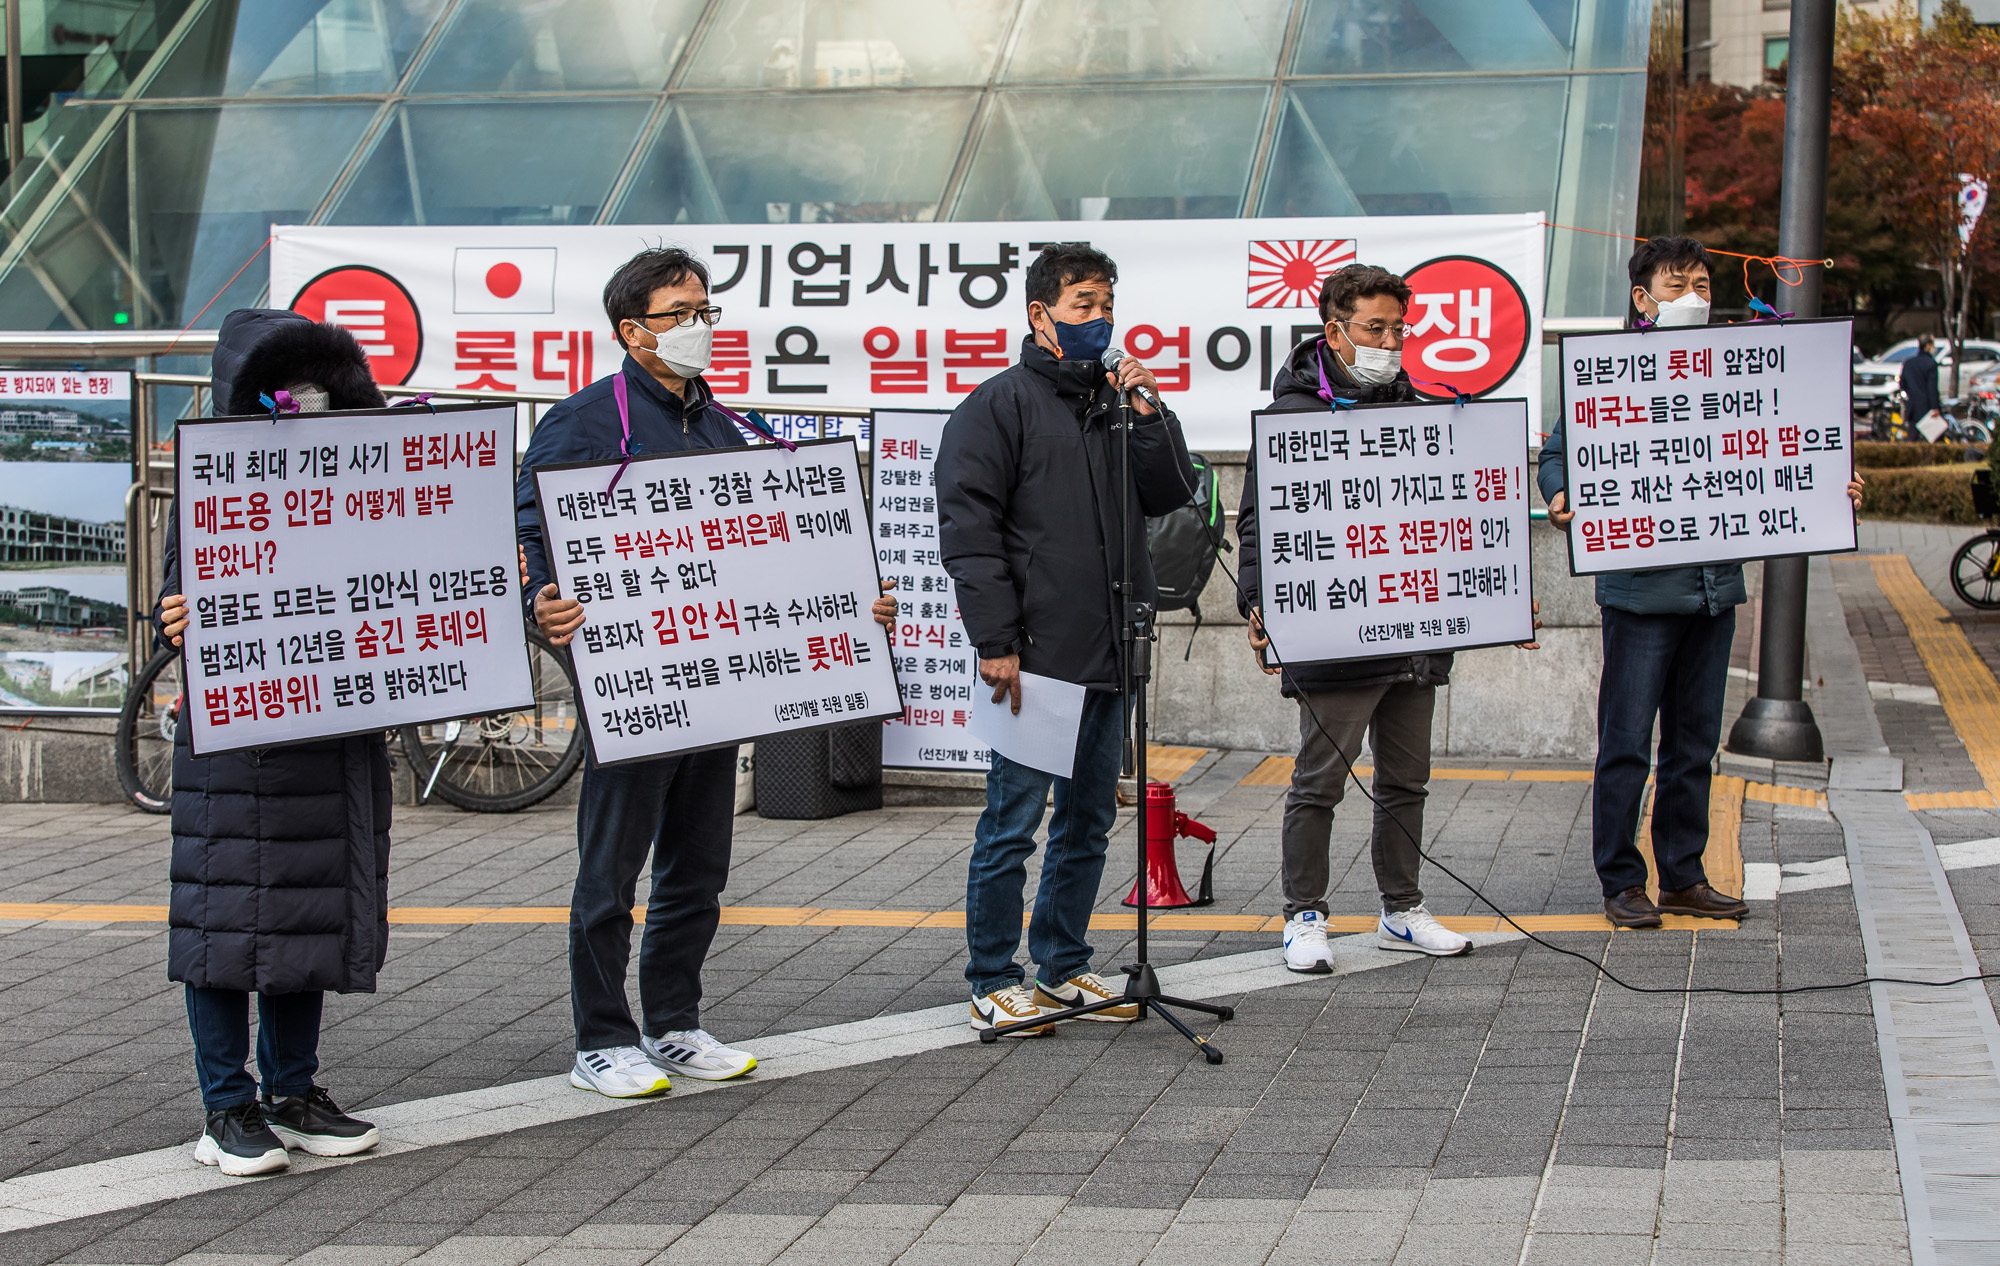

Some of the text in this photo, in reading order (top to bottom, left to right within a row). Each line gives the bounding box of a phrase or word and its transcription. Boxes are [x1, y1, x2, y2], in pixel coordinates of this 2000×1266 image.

[711, 242, 1091, 309] 기업사냥
[1413, 287, 1493, 373] 쟁
[455, 326, 830, 396] 롯데룹은
[1573, 345, 1785, 386] 일본기업 롯데 앞잡이
[14, 377, 55, 394] 방치되어
[62, 377, 82, 394] 있는
[89, 378, 113, 394] 현장!
[1575, 393, 1691, 429] 매국노들은
[1700, 389, 1763, 420] 들어라
[193, 430, 497, 485] 국내 최대 기업 사기 범죄사실
[880, 438, 933, 460] 롯데는
[1268, 429, 1350, 464] 대한민국
[1359, 425, 1416, 457] 노른자
[1424, 424, 1441, 456] 땅
[1577, 425, 1843, 472] 이나라 국민이 피와 땀으로
[557, 487, 638, 522] 대한민국
[762, 464, 846, 501] 수사관을
[880, 470, 922, 486] 강탈한
[1270, 479, 1332, 513] 그렇게
[1342, 475, 1382, 510] 많이
[1391, 473, 1445, 506] 가지고
[1452, 473, 1468, 500] 또
[1474, 466, 1507, 502] 강탈
[1578, 463, 1814, 507] 모은 재산 수천억이 매년
[194, 484, 454, 535] 매도용 인감 어떻게 발부
[879, 496, 936, 513] 사업권을
[566, 508, 852, 565] 모두 부실수사 범죄은폐 막이에
[879, 522, 935, 539] 돌려주고
[1272, 516, 1510, 564] 롯데는 위조 전문기업 인가
[1581, 507, 1806, 552] 일본땅으로 가고 있다.
[195, 540, 277, 580] 받았나?
[879, 549, 906, 565] 이제
[197, 565, 508, 628] 얼굴도 모르는 김안식 인감도용
[573, 559, 717, 604] 동원 할 수 없다
[921, 576, 948, 592] 훔친
[1274, 579, 1317, 614] 뒤에
[1326, 576, 1368, 610] 숨어
[1378, 567, 1440, 604] 도적질
[1447, 564, 1507, 598] 그만해라
[582, 591, 858, 654] 범죄자 김안식 구속 수사하라
[920, 602, 947, 619] 훔친
[1358, 616, 1471, 643] (선진개발 직원 일동)
[201, 607, 488, 677] 범죄자 12년을 숨긴 롯데의
[594, 632, 871, 701] 이나라 국법을 무시하는 롯데는
[924, 657, 966, 674] 증거에
[204, 660, 467, 726] 범죄행위! 분명 밝혀진다
[774, 690, 869, 723] (선진개발 직원 일동)
[930, 685, 970, 701] 벙어리
[602, 699, 691, 738] 각성하라!
[952, 710, 972, 728] 특
[919, 747, 968, 762] (선진개발
